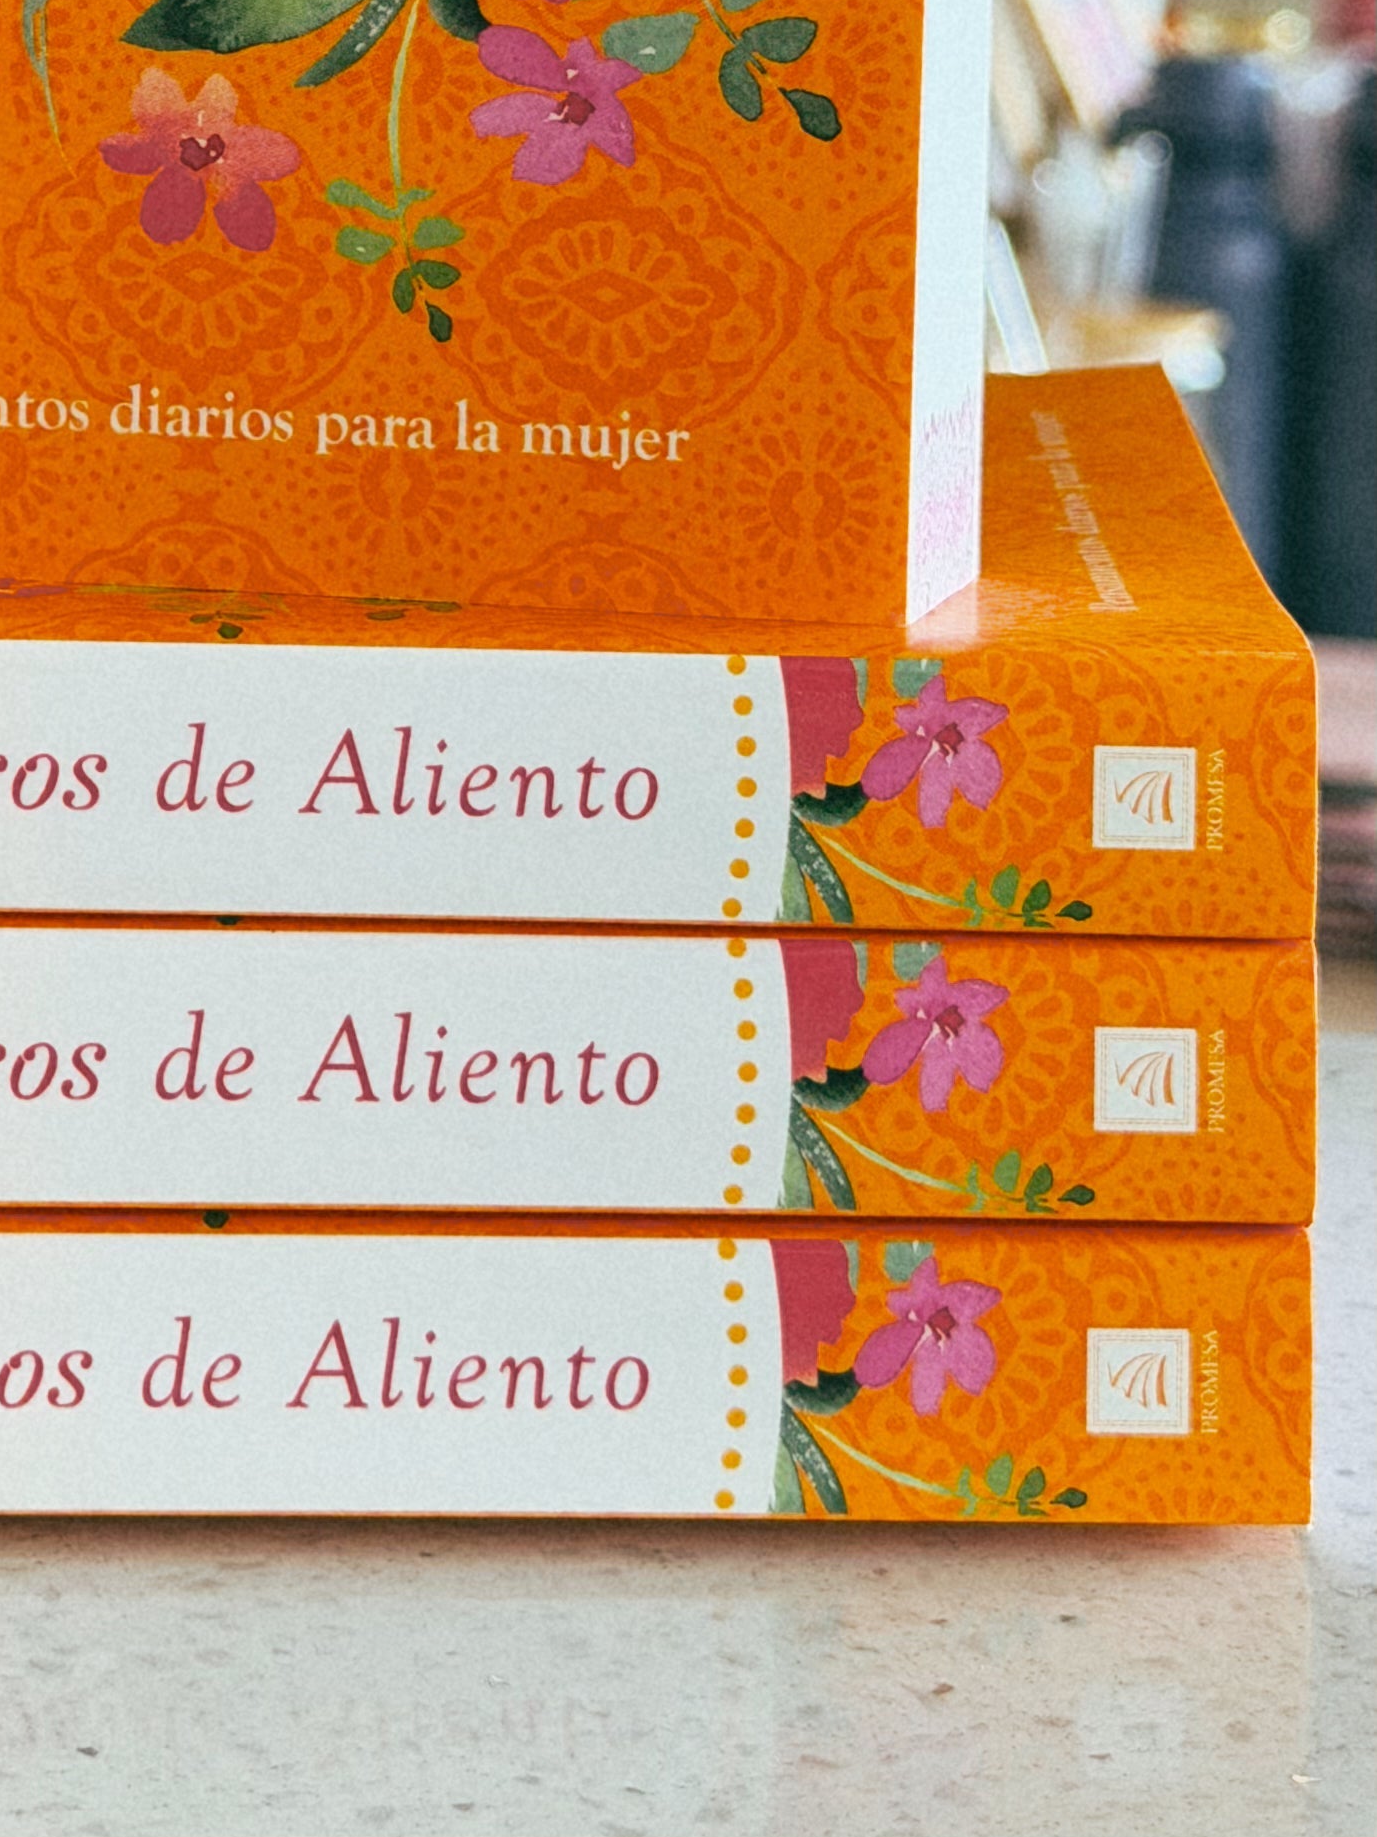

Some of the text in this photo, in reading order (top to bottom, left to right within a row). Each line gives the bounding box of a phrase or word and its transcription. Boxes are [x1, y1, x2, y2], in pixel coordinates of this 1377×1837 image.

[109, 384, 295, 443] diarios
[315, 411, 437, 455] para
[455, 400, 501, 454] la
[521, 410, 692, 470] mujer
[156, 723, 256, 815] de
[299, 727, 660, 822] Aliento
[1206, 749, 1224, 851] PROMESA
[155, 1011, 256, 1103] de
[298, 1013, 661, 1108] Aliento
[1207, 1029, 1225, 1133] PROMESA
[142, 1317, 243, 1410] de
[287, 1318, 651, 1413] Aliento
[1200, 1329, 1219, 1433] PROMESA
